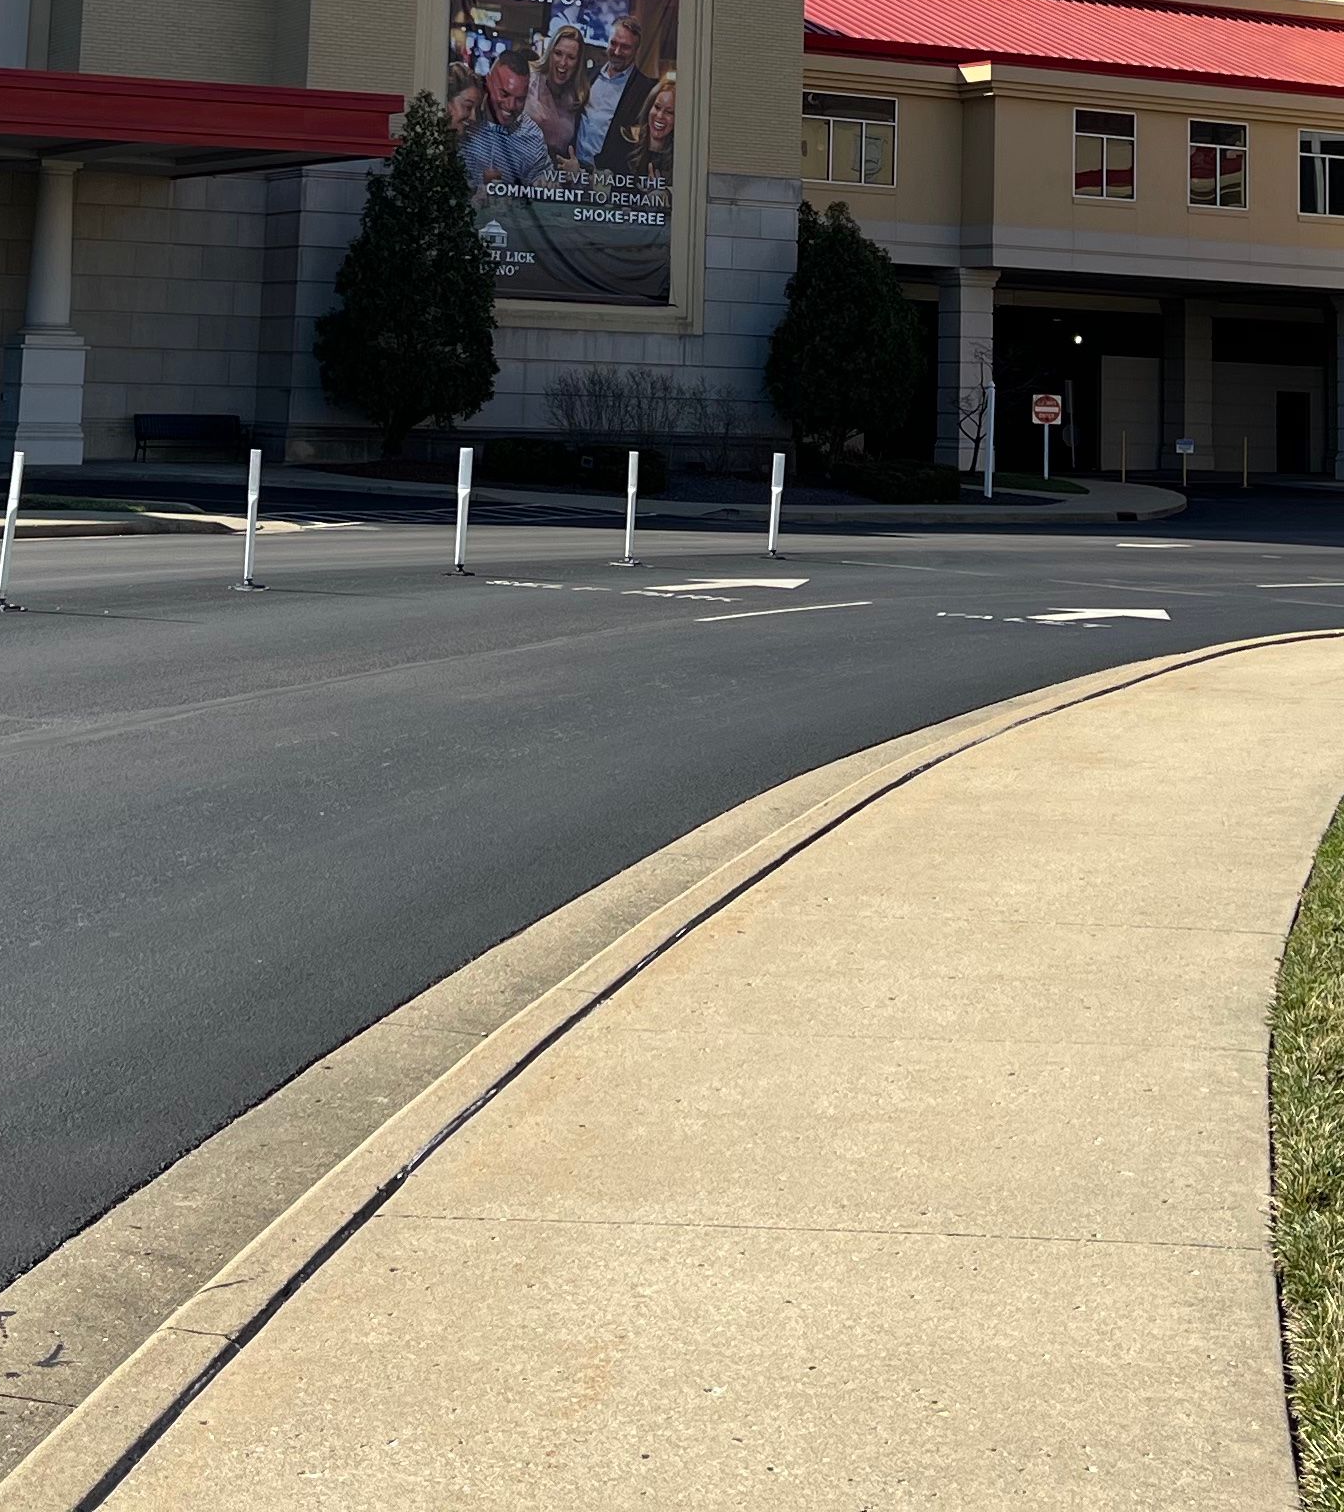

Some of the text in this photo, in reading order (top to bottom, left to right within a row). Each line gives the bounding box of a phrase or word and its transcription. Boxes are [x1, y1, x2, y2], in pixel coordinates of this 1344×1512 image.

[543, 169, 666, 190] WE'VE MADE THE
[486, 182, 666, 208] COMMITMENT TO REMAIN
[573, 208, 665, 225] SMOKE-FREE
[506, 251, 536, 264] LICK
